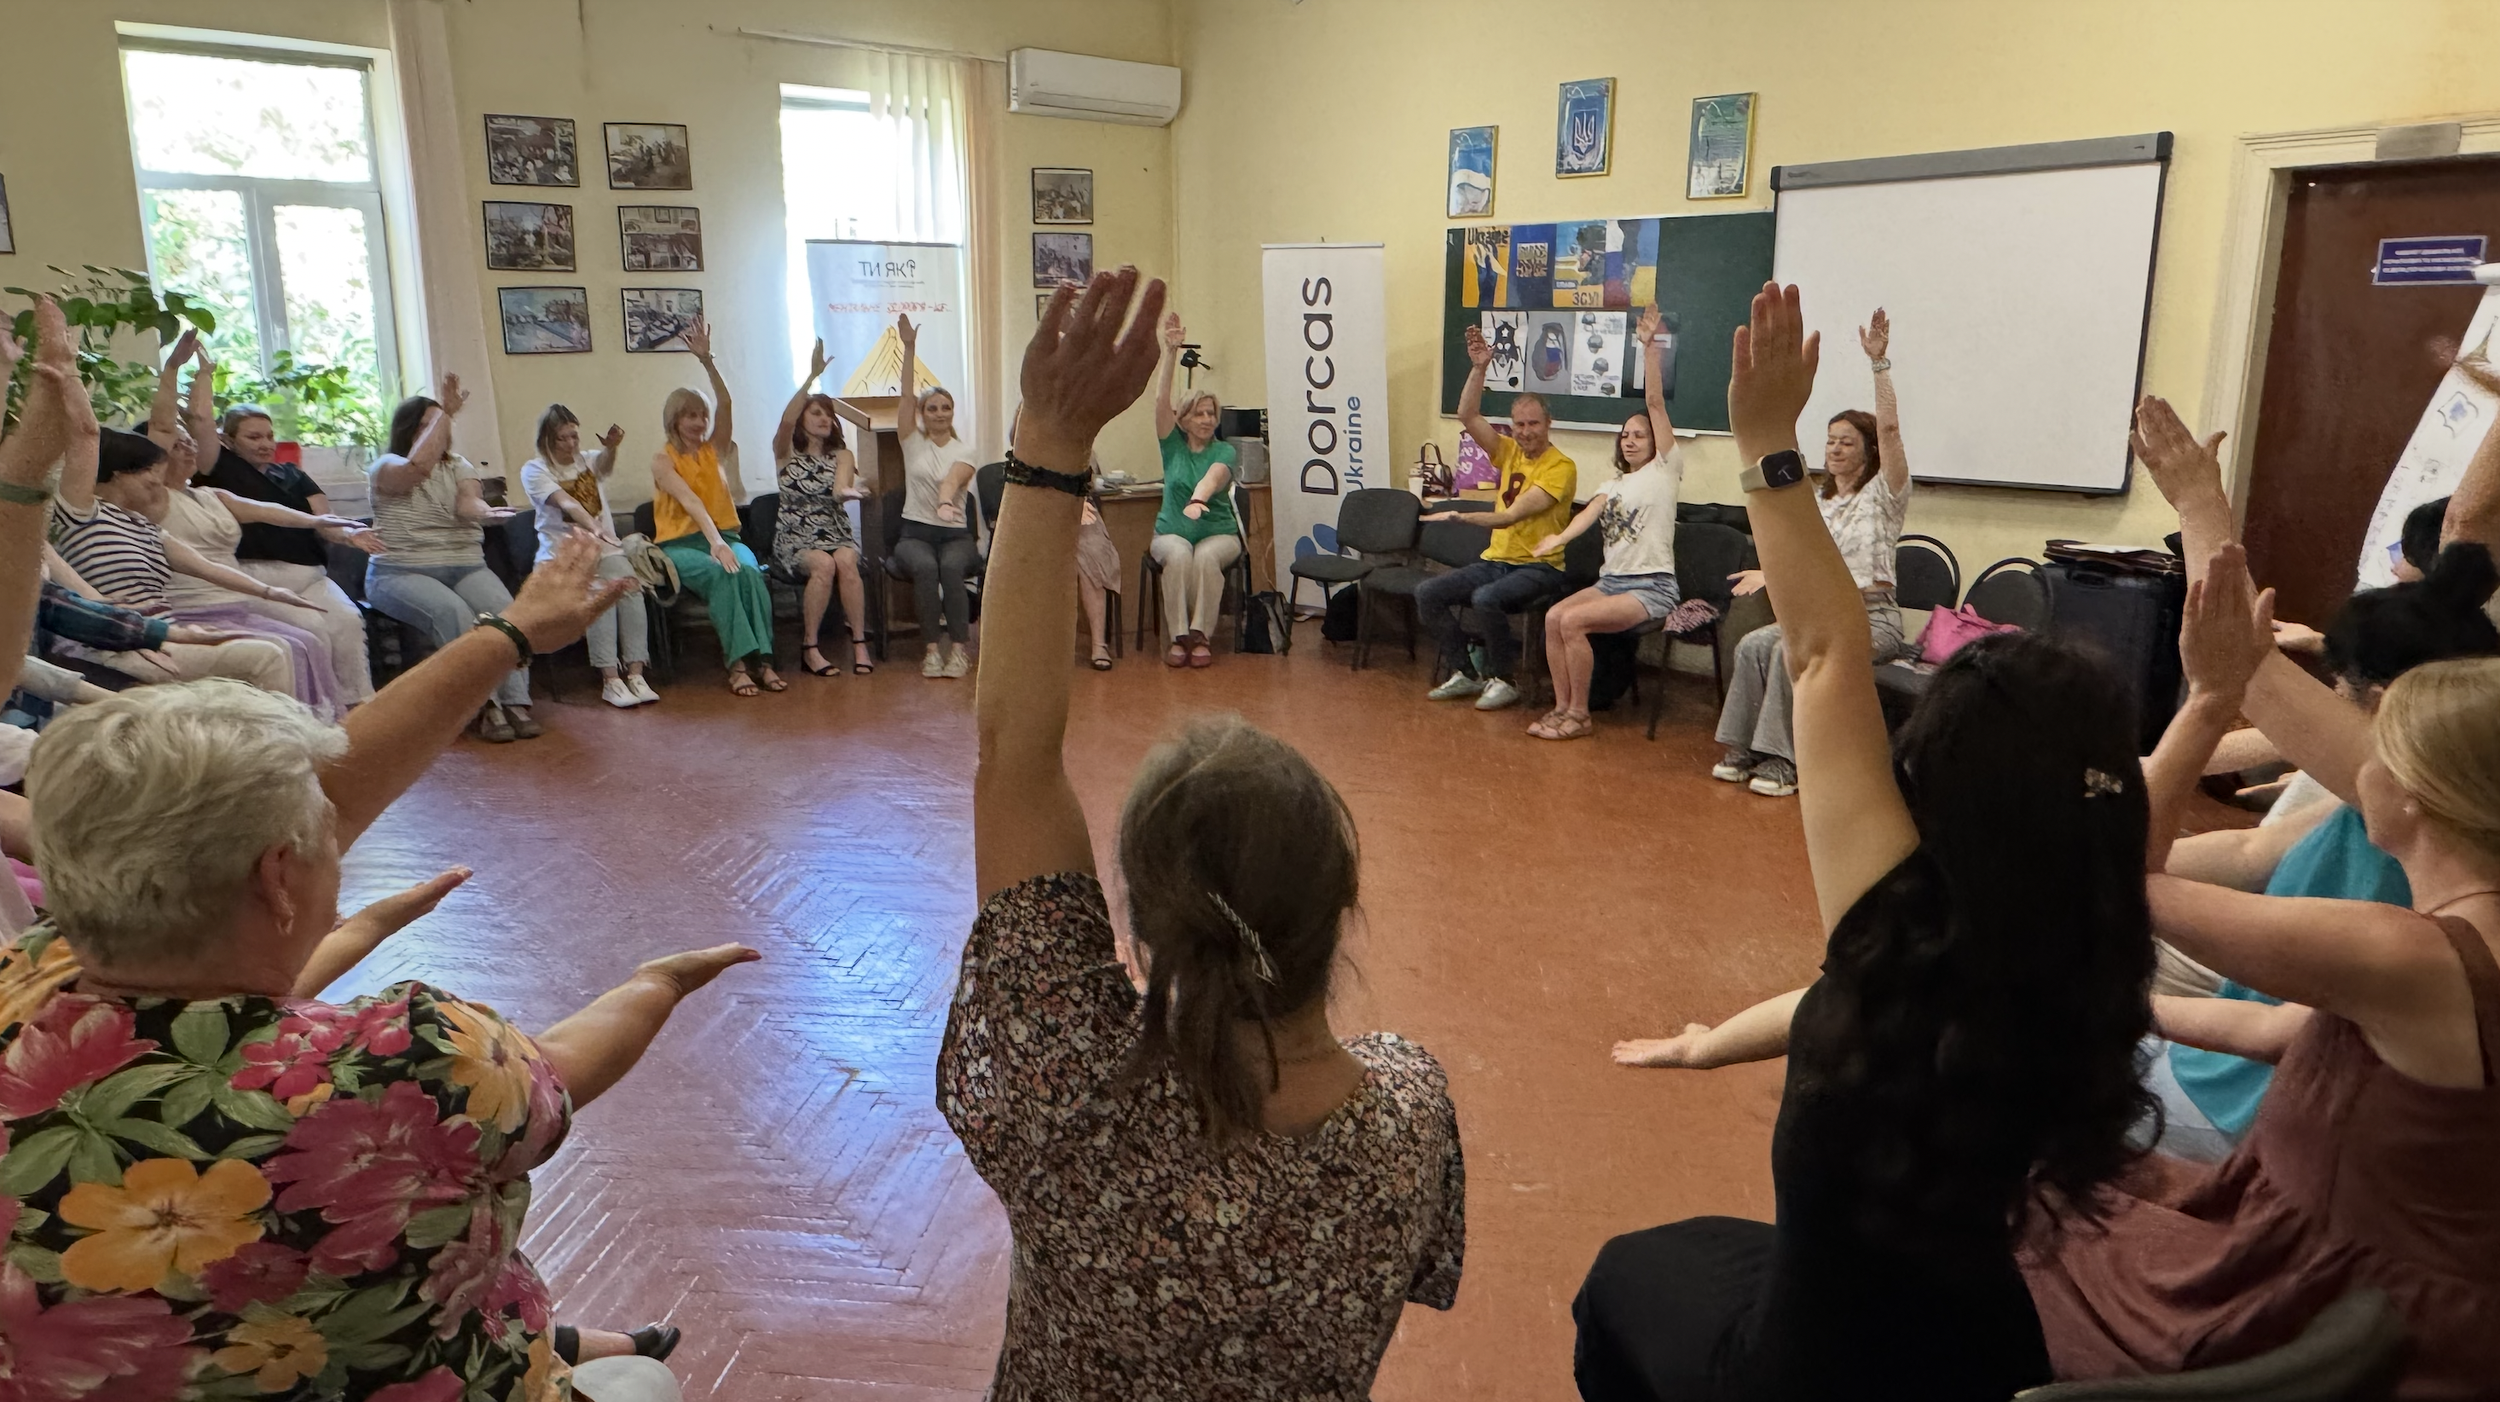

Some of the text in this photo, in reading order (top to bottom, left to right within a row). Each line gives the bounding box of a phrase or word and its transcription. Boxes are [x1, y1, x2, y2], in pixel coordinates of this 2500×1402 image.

[858, 259, 916, 278] ТИ ЯК?
[1301, 276, 1339, 496] Dorcas
